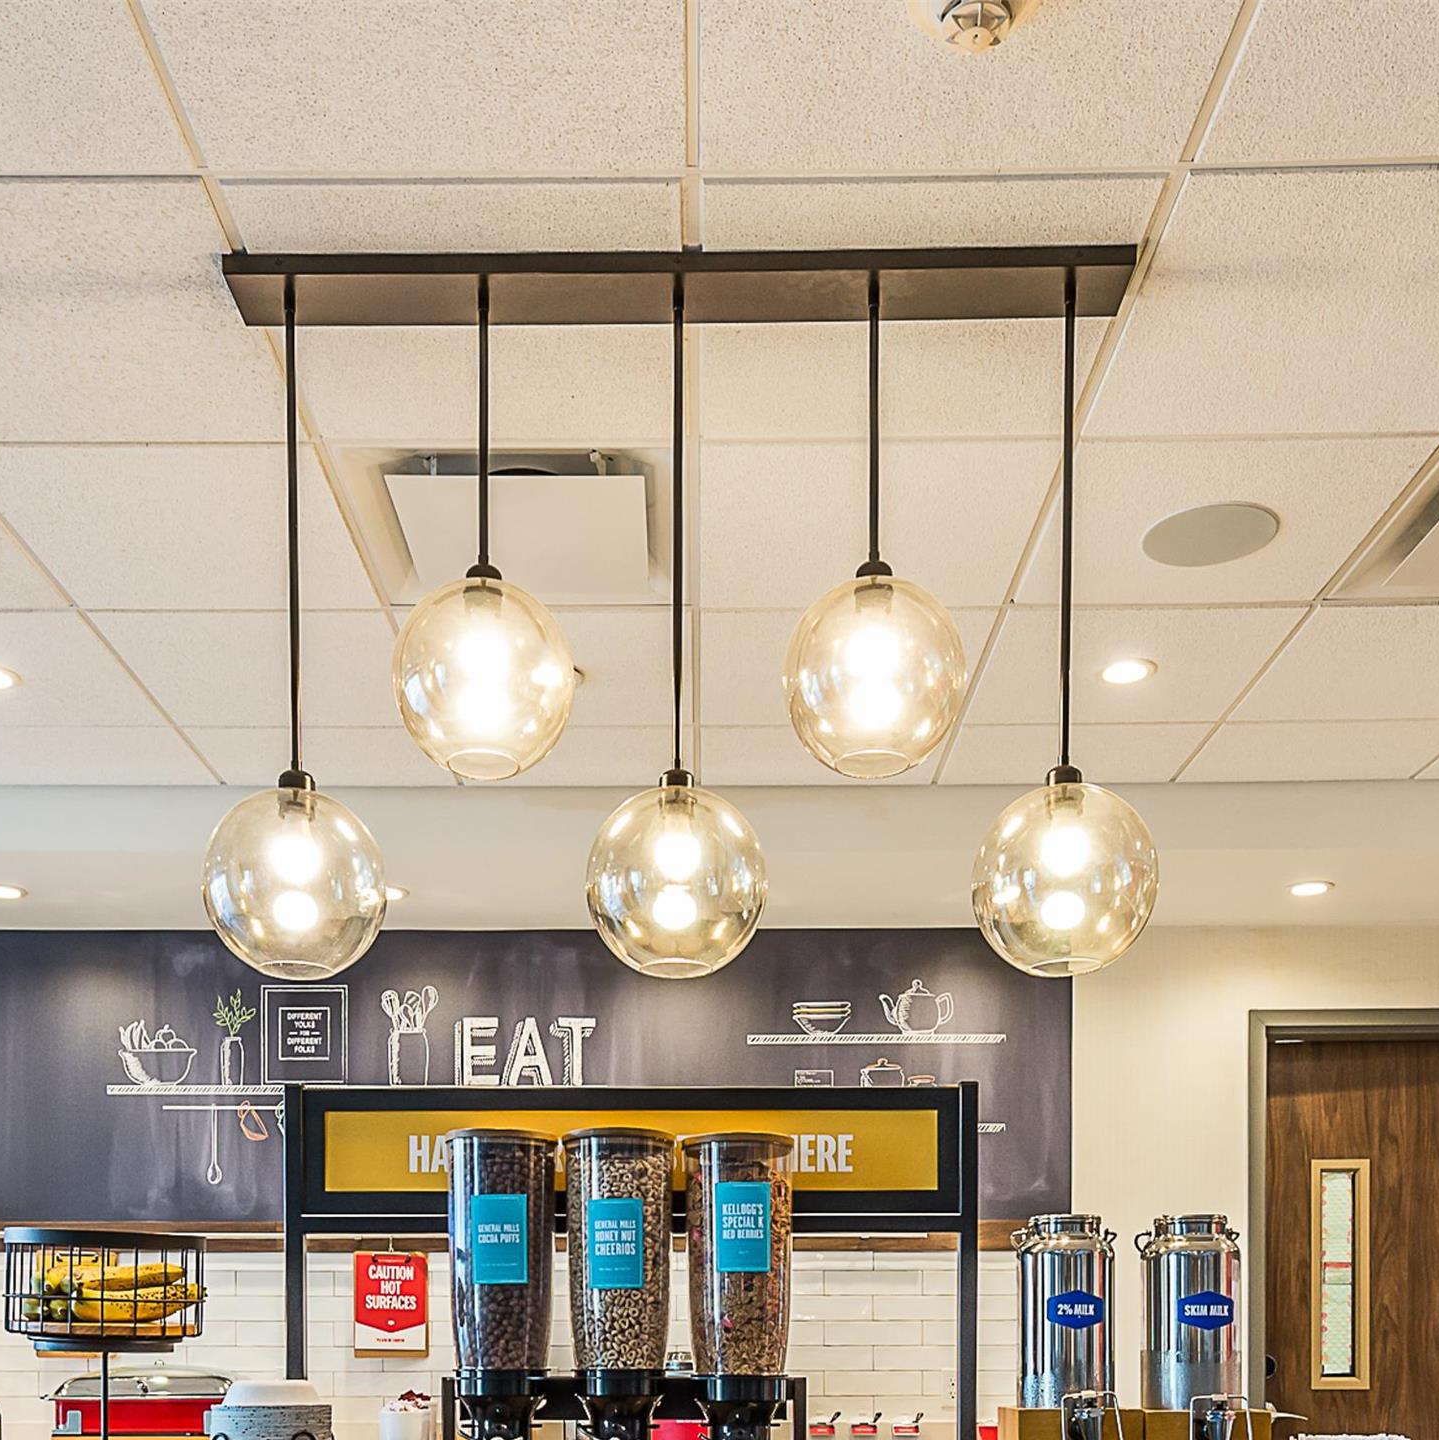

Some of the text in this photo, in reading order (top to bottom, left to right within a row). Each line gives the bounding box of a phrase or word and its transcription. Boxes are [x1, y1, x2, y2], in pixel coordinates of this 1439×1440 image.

[287, 1012, 322, 1020] DIFFERENT
[294, 1021, 315, 1029] YOLKS
[287, 1037, 322, 1045] DIFFERENT
[294, 1045, 315, 1054] FOLKS
[454, 1016, 596, 1086] EAT
[722, 1203, 764, 1215] KELLOGG'S
[594, 1220, 636, 1229] GENERAL MILLS
[722, 1216, 764, 1228] SPECIAL K
[478, 1224, 520, 1233] GENERAL MILLS
[722, 1229, 764, 1239] RED BERRIES
[478, 1234, 520, 1244] COCOA PUFFS
[595, 1230, 636, 1242] HONEY NUT
[595, 1243, 636, 1256] CHEERIOS
[368, 1265, 414, 1280] CAUTION
[380, 1281, 402, 1295] HOT
[365, 1295, 417, 1310] SURFACES
[1057, 1303, 1095, 1317] 2% MILK
[1184, 1304, 1229, 1316] SKIM MILK
